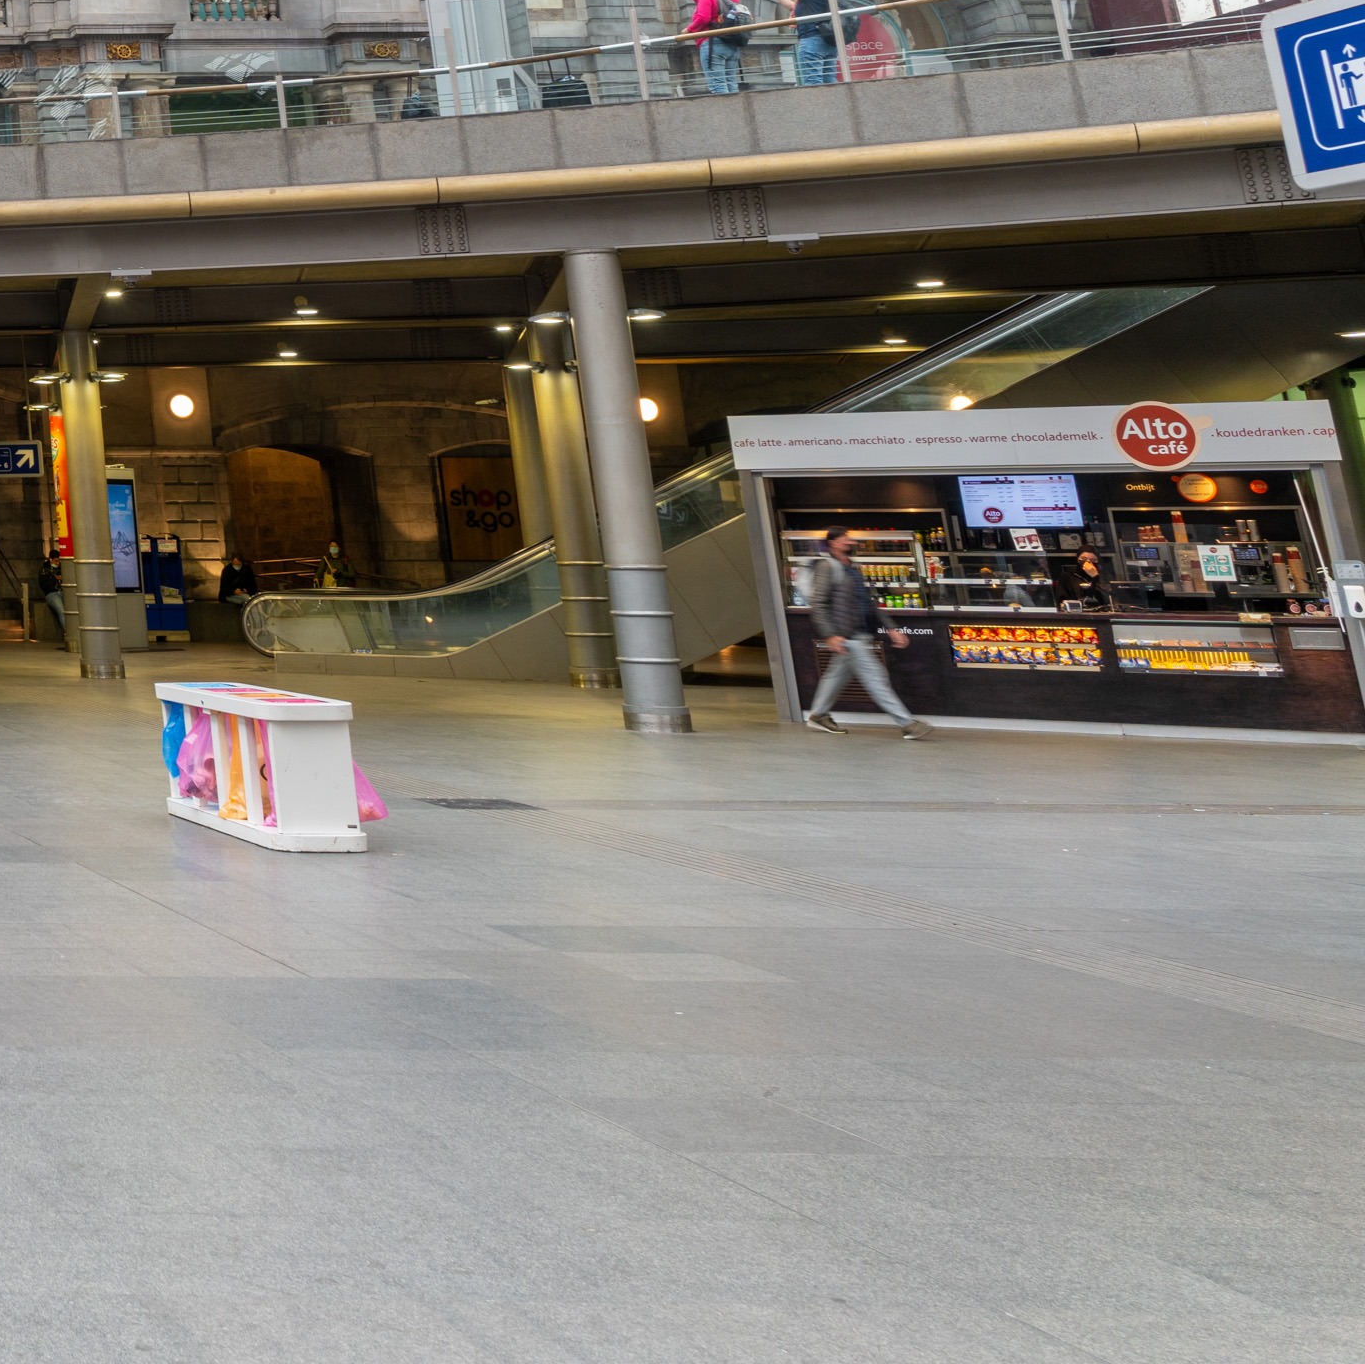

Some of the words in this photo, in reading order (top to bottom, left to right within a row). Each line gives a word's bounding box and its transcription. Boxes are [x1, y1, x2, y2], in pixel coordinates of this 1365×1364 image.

[845, 40, 884, 52] space
[1122, 417, 1188, 440] Alto
[1216, 427, 1305, 438] koudedranken
[734, 438, 755, 447] cafe
[758, 438, 782, 447] latte
[788, 437, 842, 446] americano
[849, 436, 905, 445] macchiato
[915, 436, 963, 445] espresso
[969, 434, 1007, 443] warme
[1011, 431, 1097, 442] chocolademelk
[1148, 440, 1188, 455] café
[1126, 484, 1155, 492] Ontbijt
[450, 484, 511, 511] shop
[466, 510, 515, 533] &go
